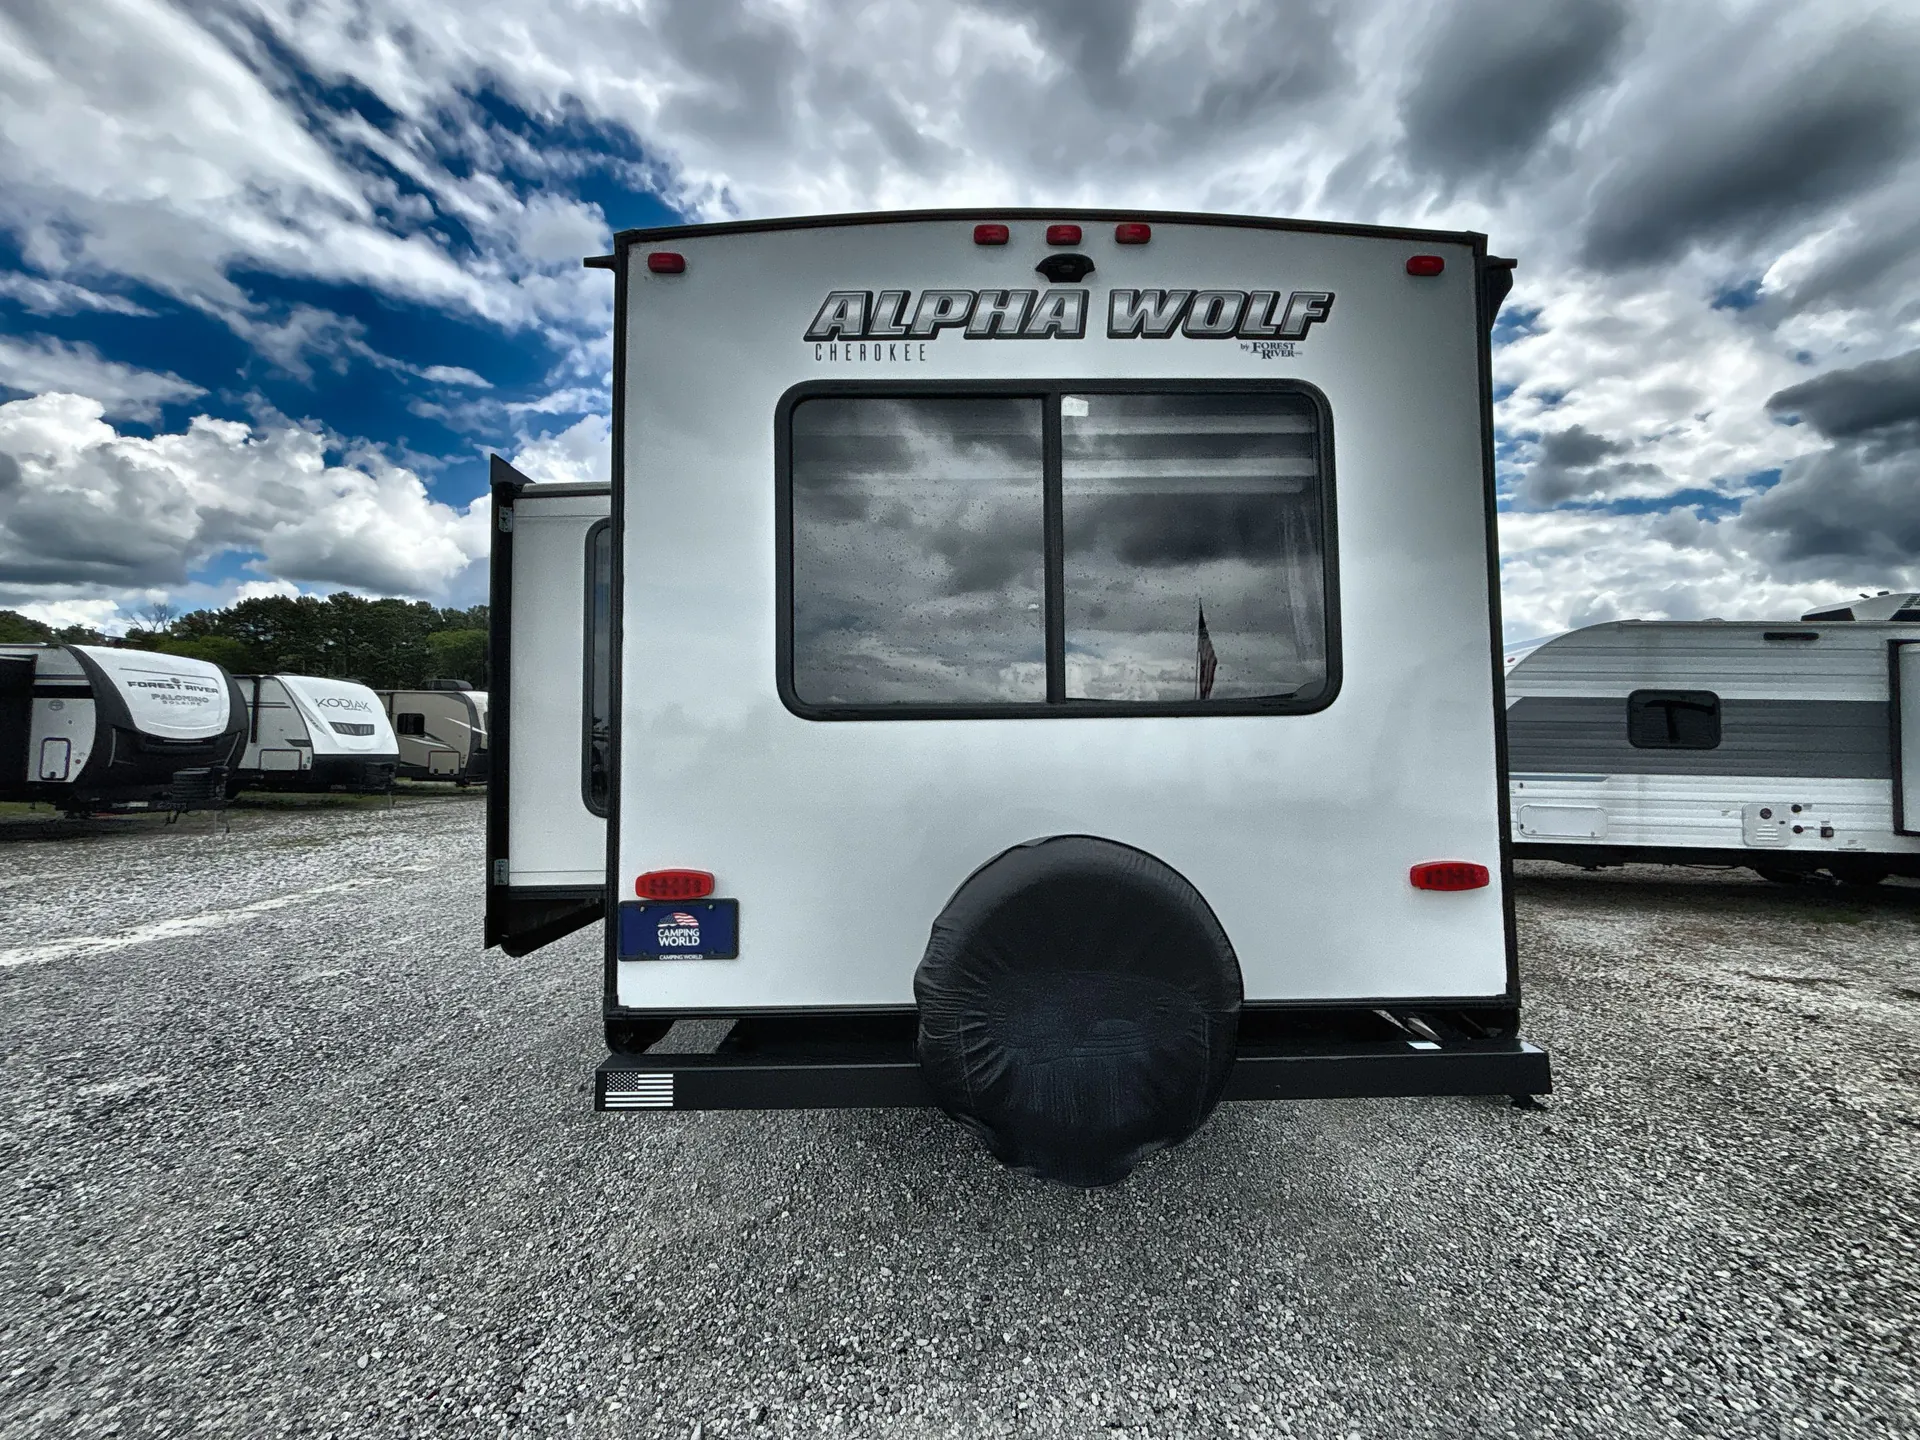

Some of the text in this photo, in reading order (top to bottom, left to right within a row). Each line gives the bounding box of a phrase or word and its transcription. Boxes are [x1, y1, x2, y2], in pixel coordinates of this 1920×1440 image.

[803, 289, 1336, 342] ALPHA WOLF
[815, 343, 926, 362] CHEROKEE
[1240, 341, 1296, 353] by FOREST
[1261, 349, 1295, 360] RIVER
[127, 681, 219, 694] FOREST RIVER
[151, 693, 210, 704] PALOMINO
[315, 698, 373, 713] KODIAK
[657, 928, 700, 937] CAMPING
[658, 936, 700, 947] WORLD
